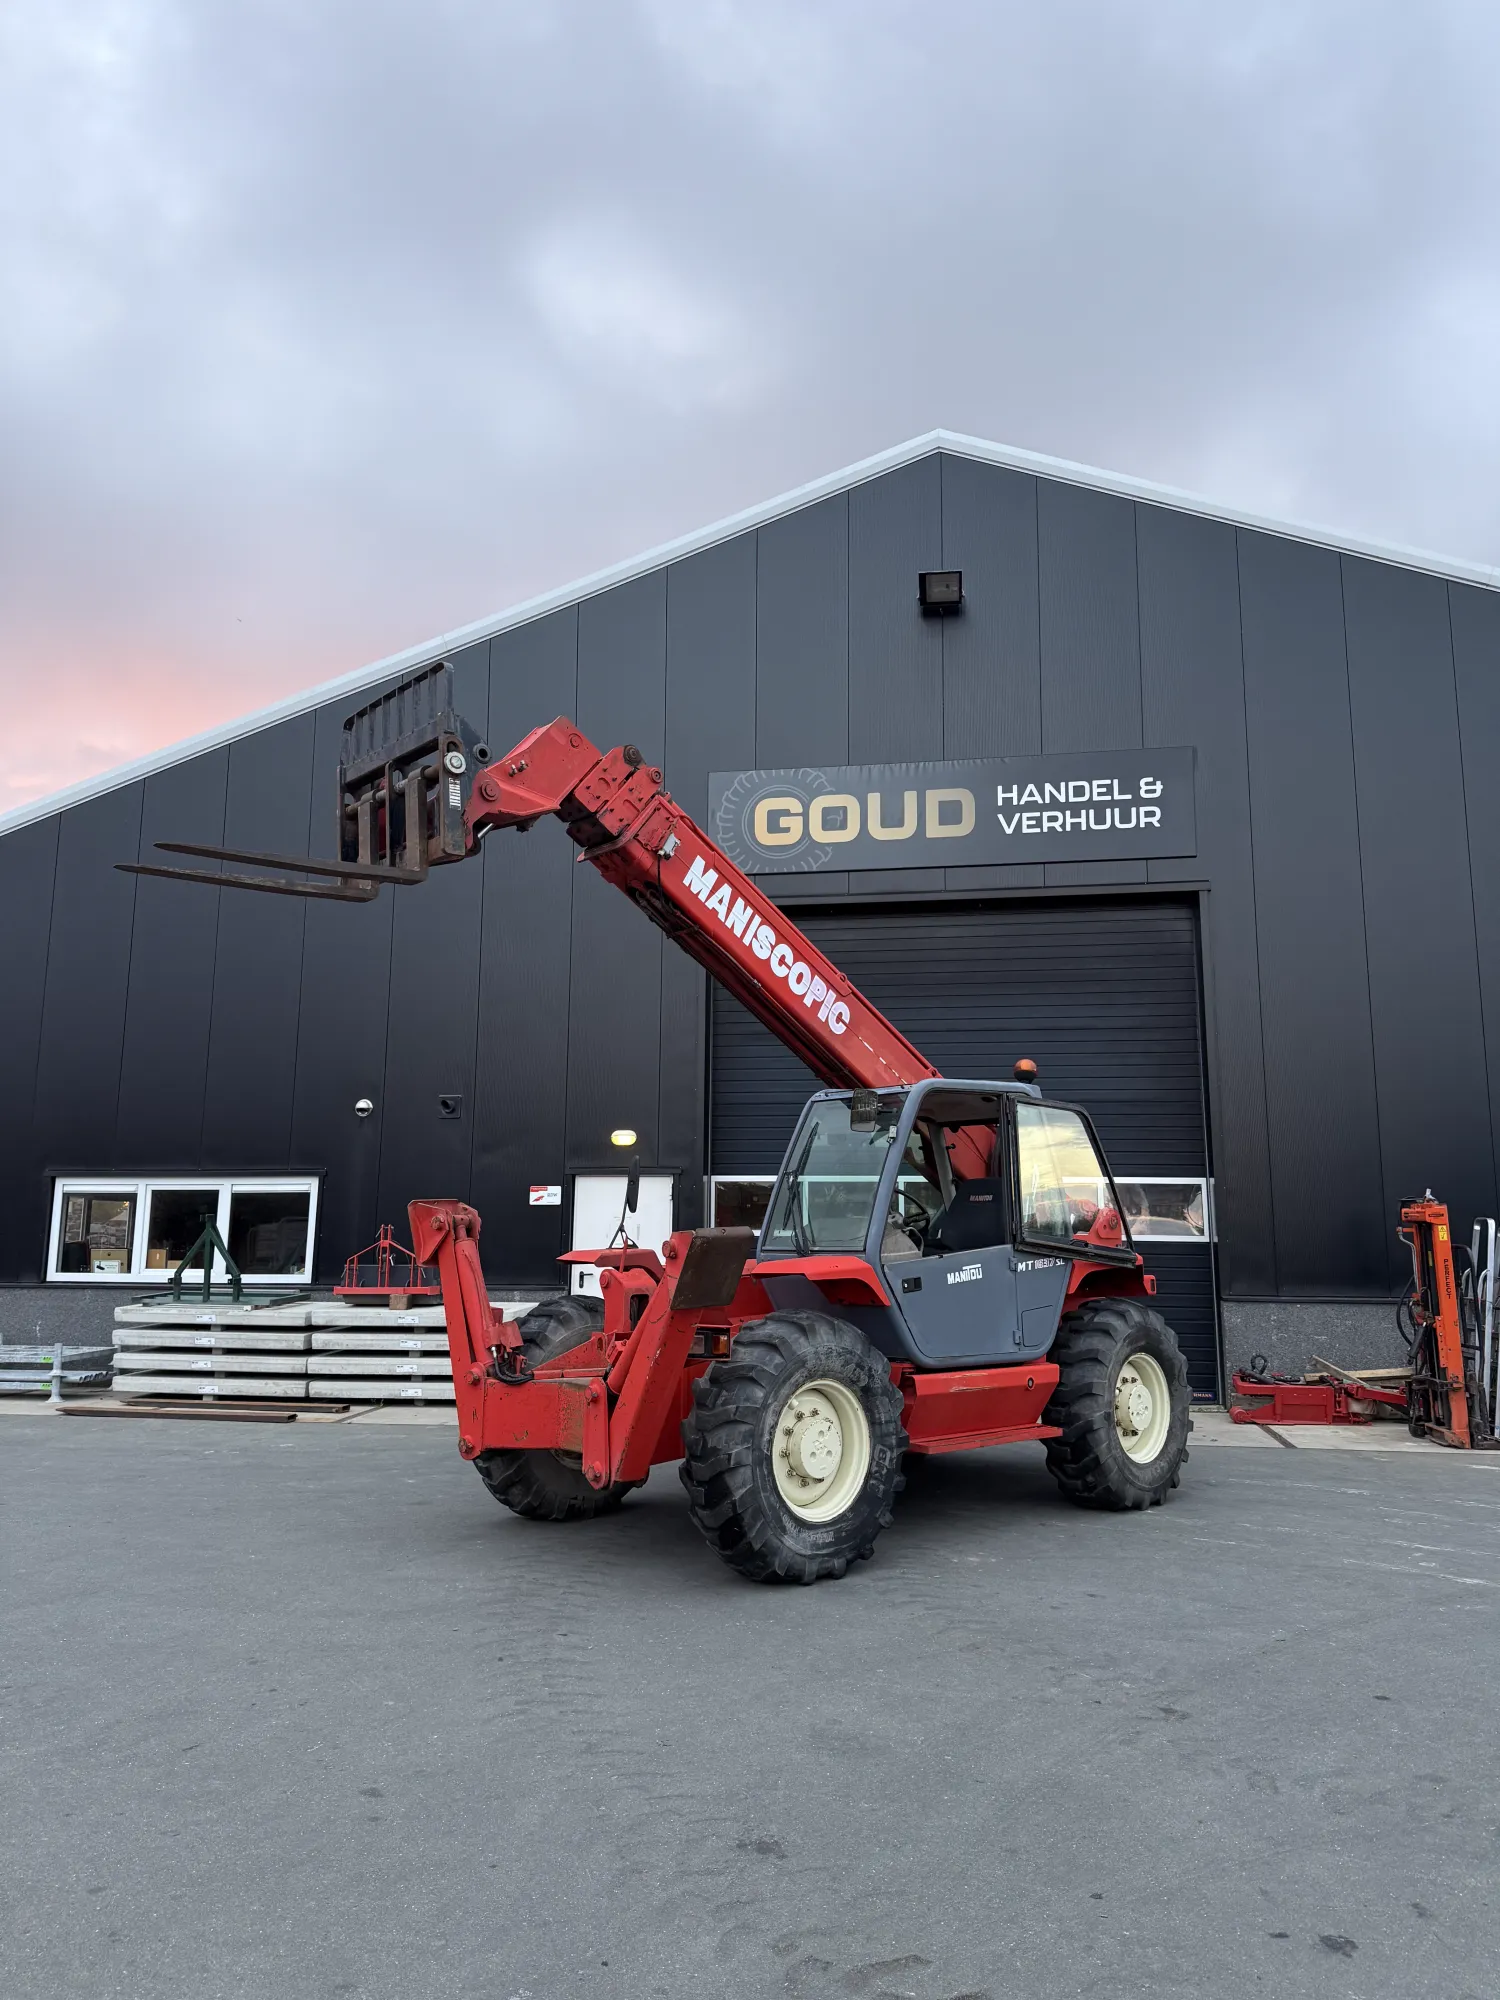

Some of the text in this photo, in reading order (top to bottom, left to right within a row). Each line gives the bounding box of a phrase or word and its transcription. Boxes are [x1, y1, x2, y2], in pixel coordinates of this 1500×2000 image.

[996, 776, 1164, 807] HANDEL &
[754, 787, 976, 846] GOUD
[996, 805, 1162, 835] VERHUUR
[682, 855, 850, 1035] MANISCOPIC
[946, 1263, 983, 1284] MANITOU
[1017, 1260, 1034, 1272] MT
[1055, 1258, 1065, 1266] SL
[1443, 1258, 1452, 1299] PERFECT
